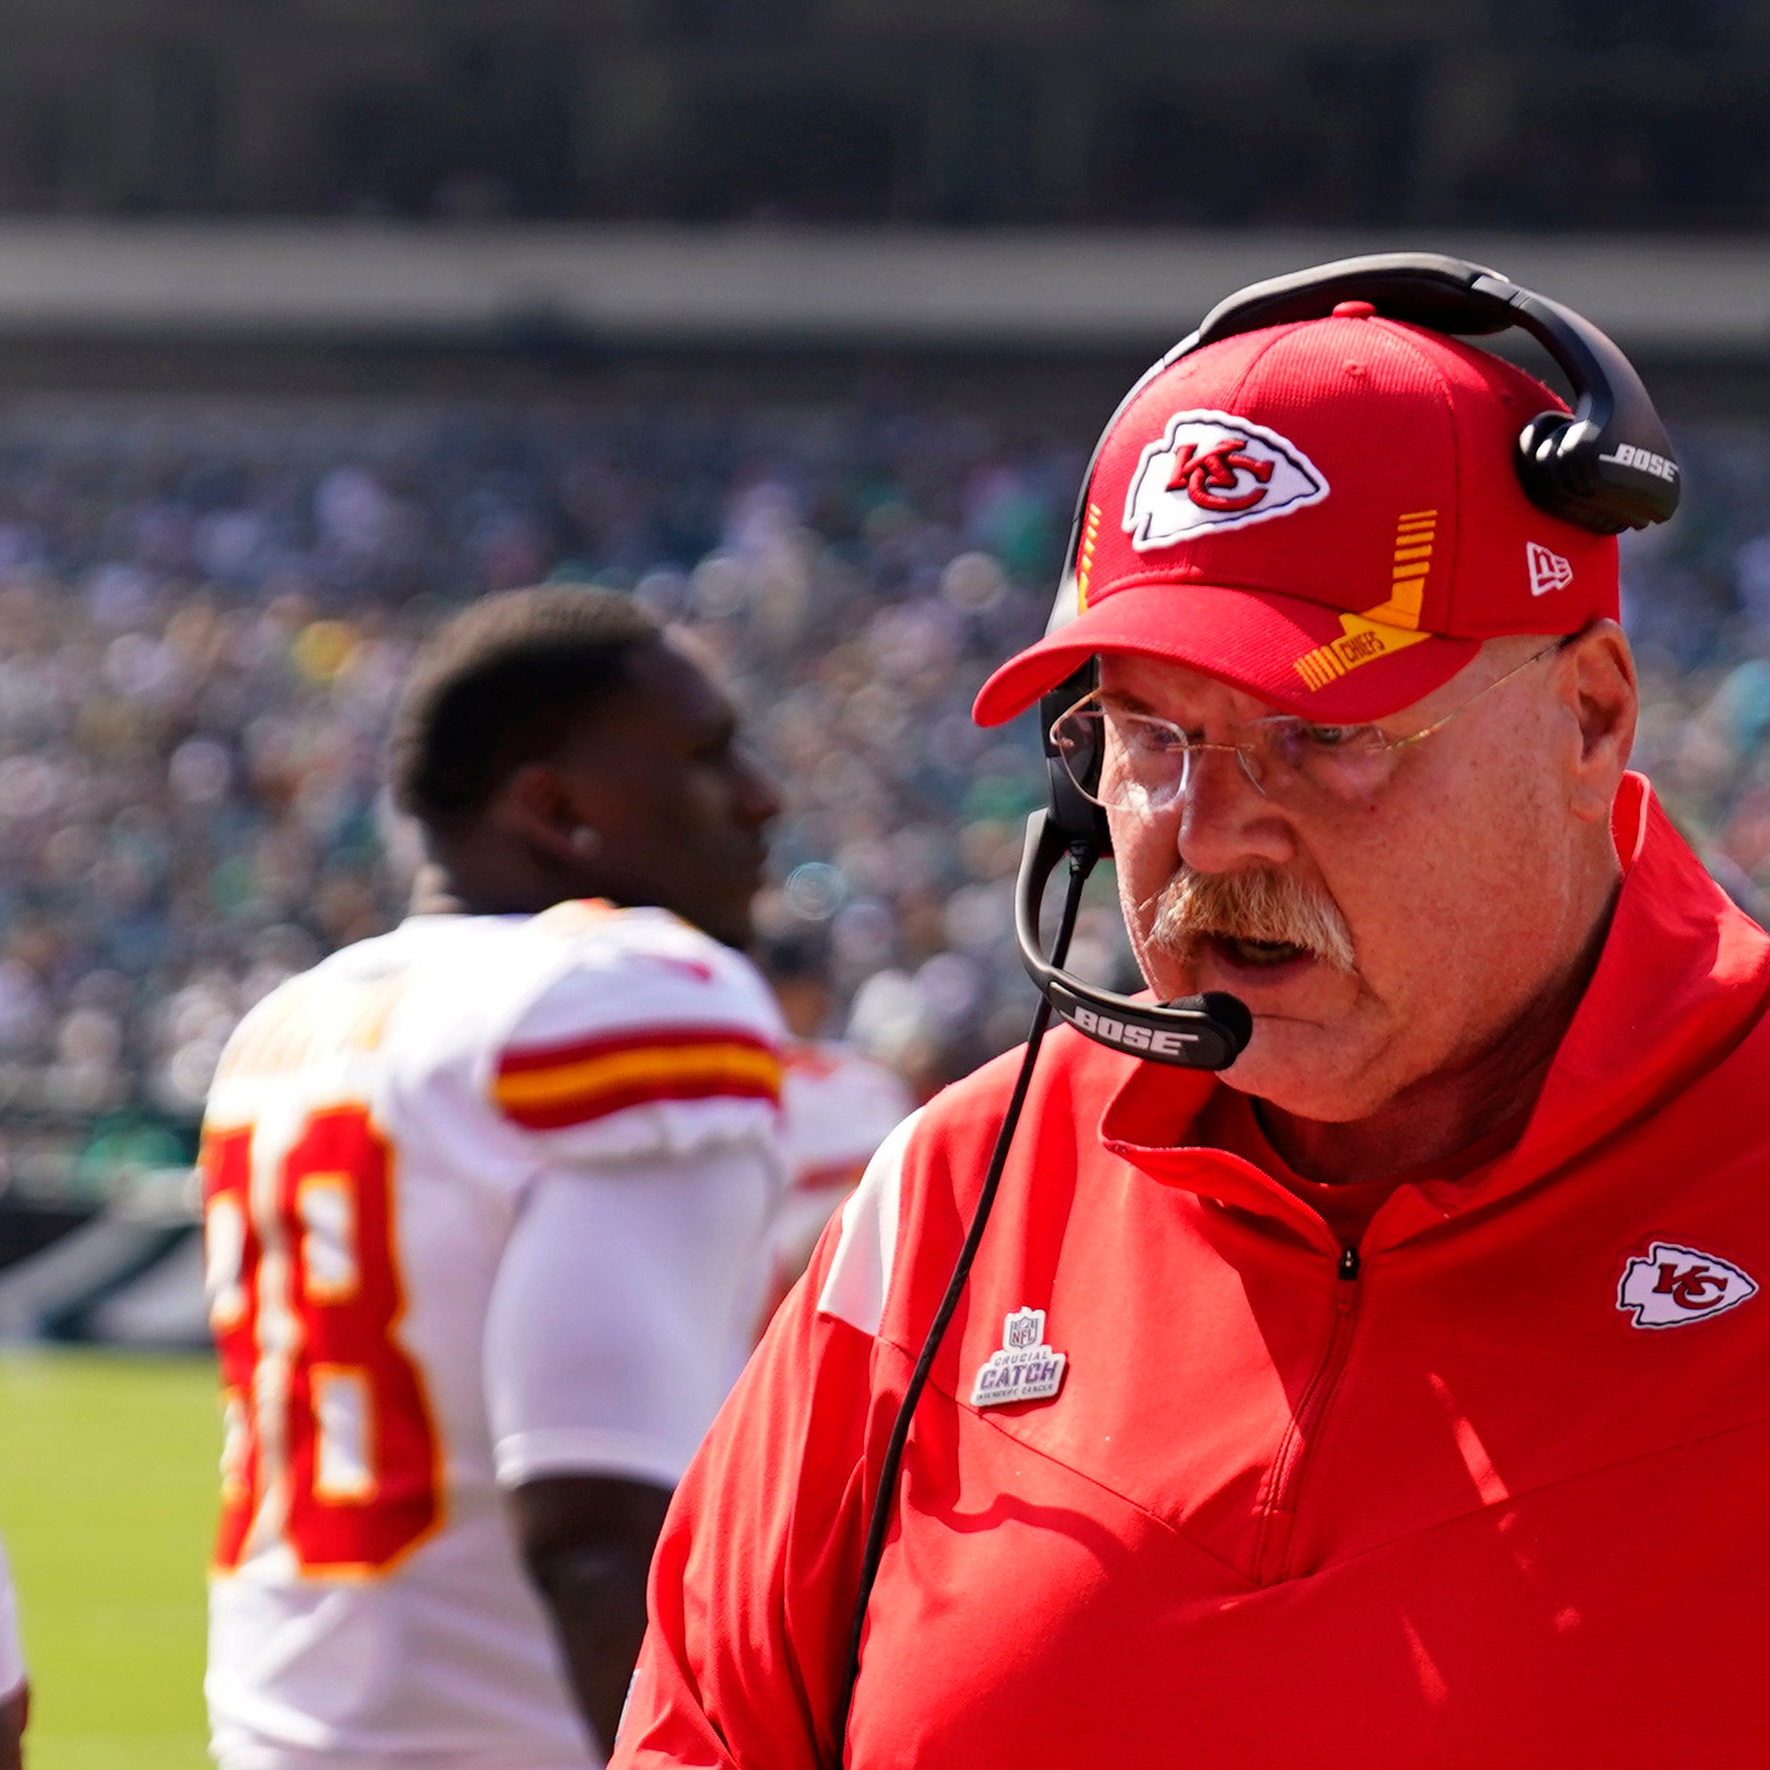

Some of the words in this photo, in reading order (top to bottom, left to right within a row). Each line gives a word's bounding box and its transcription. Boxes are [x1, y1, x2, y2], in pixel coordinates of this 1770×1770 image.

[1165, 438, 1275, 513] KC
[1599, 443, 1679, 483] BOSE
[1340, 631, 1385, 662] CHIEFS
[1059, 1005, 1199, 1056] BOSE
[1652, 1262, 1729, 1310] KC
[1011, 1328, 1034, 1345] NFL
[980, 1360, 1058, 1391] CATCH
